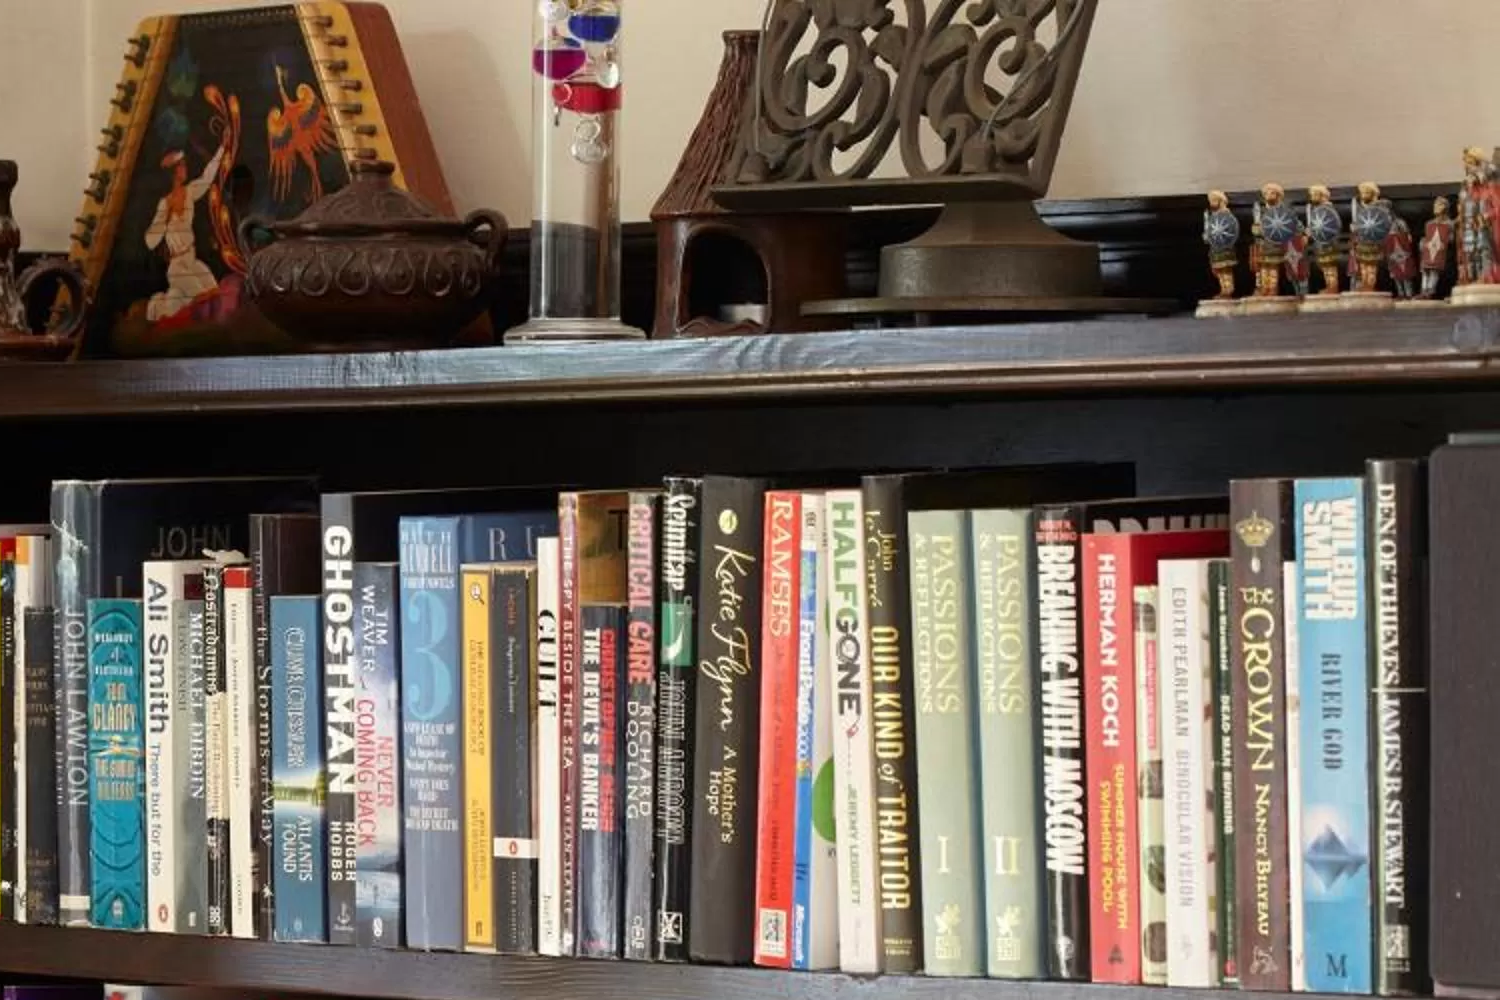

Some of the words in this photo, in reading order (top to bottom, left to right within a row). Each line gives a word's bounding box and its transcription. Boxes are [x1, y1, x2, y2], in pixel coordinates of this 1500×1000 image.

[1378, 483, 1396, 534] DEN
[628, 503, 651, 610] CRITICAL
[711, 545, 756, 621] Katie
[770, 498, 792, 639] RAMSES
[1304, 502, 1333, 619] SMITH
[1332, 498, 1356, 619] WILBUR
[1379, 540, 1398, 578] OF
[147, 578, 167, 622] Ali
[361, 585, 376, 671] WEAVER
[375, 611, 388, 645] TIM
[931, 534, 960, 713] PASSIONS
[995, 534, 1022, 713] PASSIONS
[1038, 546, 1075, 673] BREAKING
[1097, 553, 1117, 666] HERMAN
[1172, 587, 1187, 637] EDITH
[1380, 577, 1400, 684] THIEVES
[66, 608, 85, 678] JOHN
[324, 525, 354, 793] GHOSTMAN
[583, 628, 599, 664] THE
[629, 621, 653, 685] CARE
[870, 625, 898, 681] OUR
[148, 633, 169, 734] Smith
[583, 672, 599, 745] DEVIL'S
[702, 627, 755, 731] Flynn
[1042, 679, 1078, 748] WITH
[1100, 675, 1120, 746] KOCH
[1173, 645, 1189, 737] PEARLMAN
[1241, 608, 1274, 771] CROWN
[1322, 654, 1342, 719] RIVER
[67, 689, 87, 806] LAWTON
[357, 699, 374, 783] COMING
[722, 745, 736, 761] A
[872, 692, 903, 756] KIND
[1324, 730, 1343, 770] GOD
[1382, 694, 1401, 771] JAMES
[150, 743, 161, 787] There
[377, 736, 394, 807] NEVER
[582, 754, 599, 830] BANKER
[627, 701, 639, 819] DOOLING
[639, 706, 652, 816] RICHARD
[707, 771, 722, 815] Hope
[880, 763, 903, 785] of
[1113, 763, 1125, 826] SUMMER
[1384, 775, 1400, 796] B.
[150, 792, 163, 818] but
[358, 790, 376, 846] BACK
[720, 766, 736, 843] Mother's
[1045, 755, 1083, 874] MOSCOW
[1099, 781, 1113, 862] SWIMMING
[1175, 750, 1192, 844] BINOCULAR
[1254, 784, 1270, 857] NANCY
[151, 824, 163, 845] for
[151, 851, 163, 876] the
[282, 823, 297, 872] FOUND
[297, 816, 313, 881] ATLANTIS
[331, 821, 342, 881] HOBBS
[345, 821, 356, 881] ROGER
[877, 794, 910, 909] TRAITOR
[1115, 833, 1126, 883] HOUSE
[1383, 799, 1405, 907] STEWART
[1102, 867, 1114, 911] POOL
[1116, 888, 1128, 929] WITH
[1178, 850, 1194, 907] VISION
[1255, 860, 1271, 936] BILYEAU
